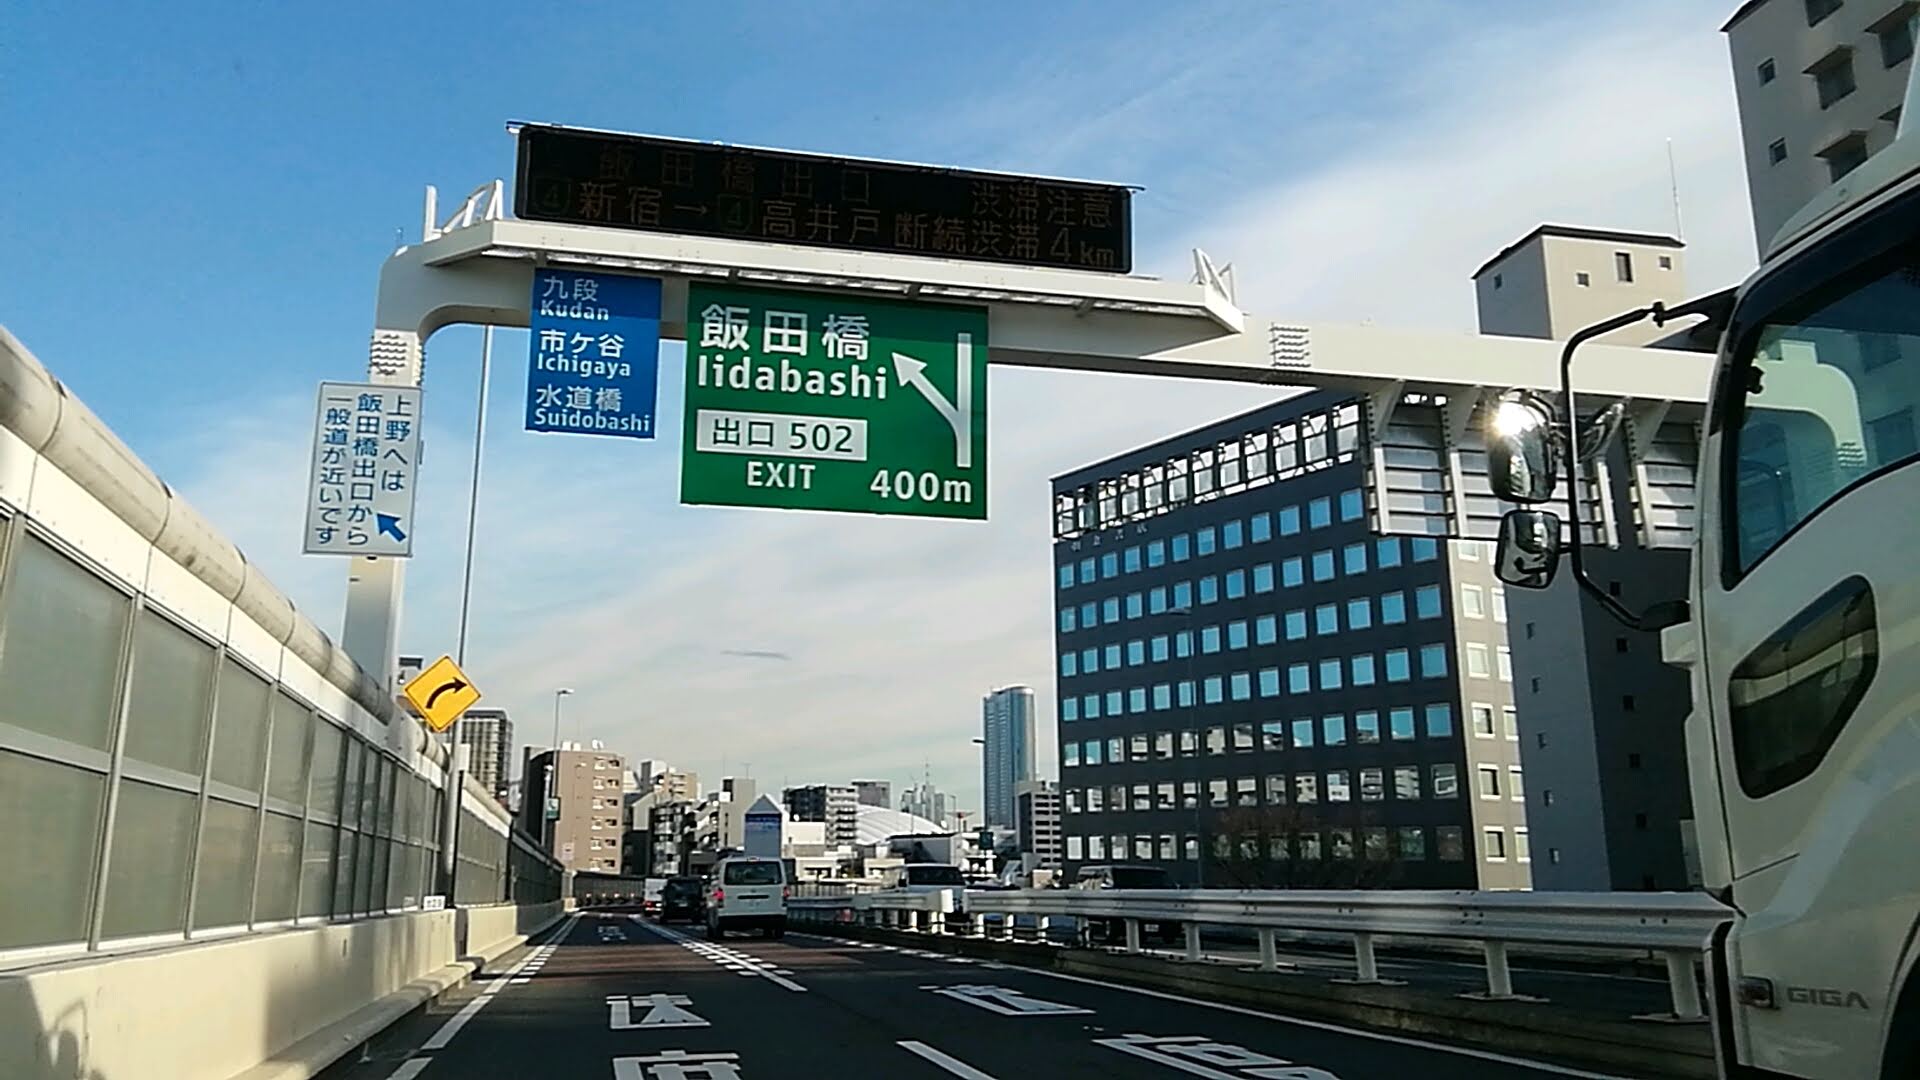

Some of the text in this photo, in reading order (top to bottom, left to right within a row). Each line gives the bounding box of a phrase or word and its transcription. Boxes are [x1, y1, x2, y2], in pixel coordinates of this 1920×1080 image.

[576, 180, 664, 227] 新宿
[762, 198, 881, 244] 高井戸
[894, 212, 1040, 260] 断続渋滞
[972, 181, 1114, 230] 渋滞注意
[542, 276, 599, 301] 九段
[540, 300, 609, 320] Kudan
[700, 303, 871, 361] 飯田橋
[537, 353, 631, 379] Ichigaya
[698, 353, 887, 399] Iidabashi
[536, 384, 622, 412] 水道橋
[534, 408, 650, 432] Suidobashi
[712, 417, 853, 453] 出口 502
[381, 394, 412, 491] 上野へは
[315, 397, 353, 545] 一般道が近いです
[347, 393, 383, 546] 飯田橋出口から
[747, 461, 816, 490] EXIT
[870, 469, 972, 503] 400m
[1786, 987, 1869, 1010] GIGA
